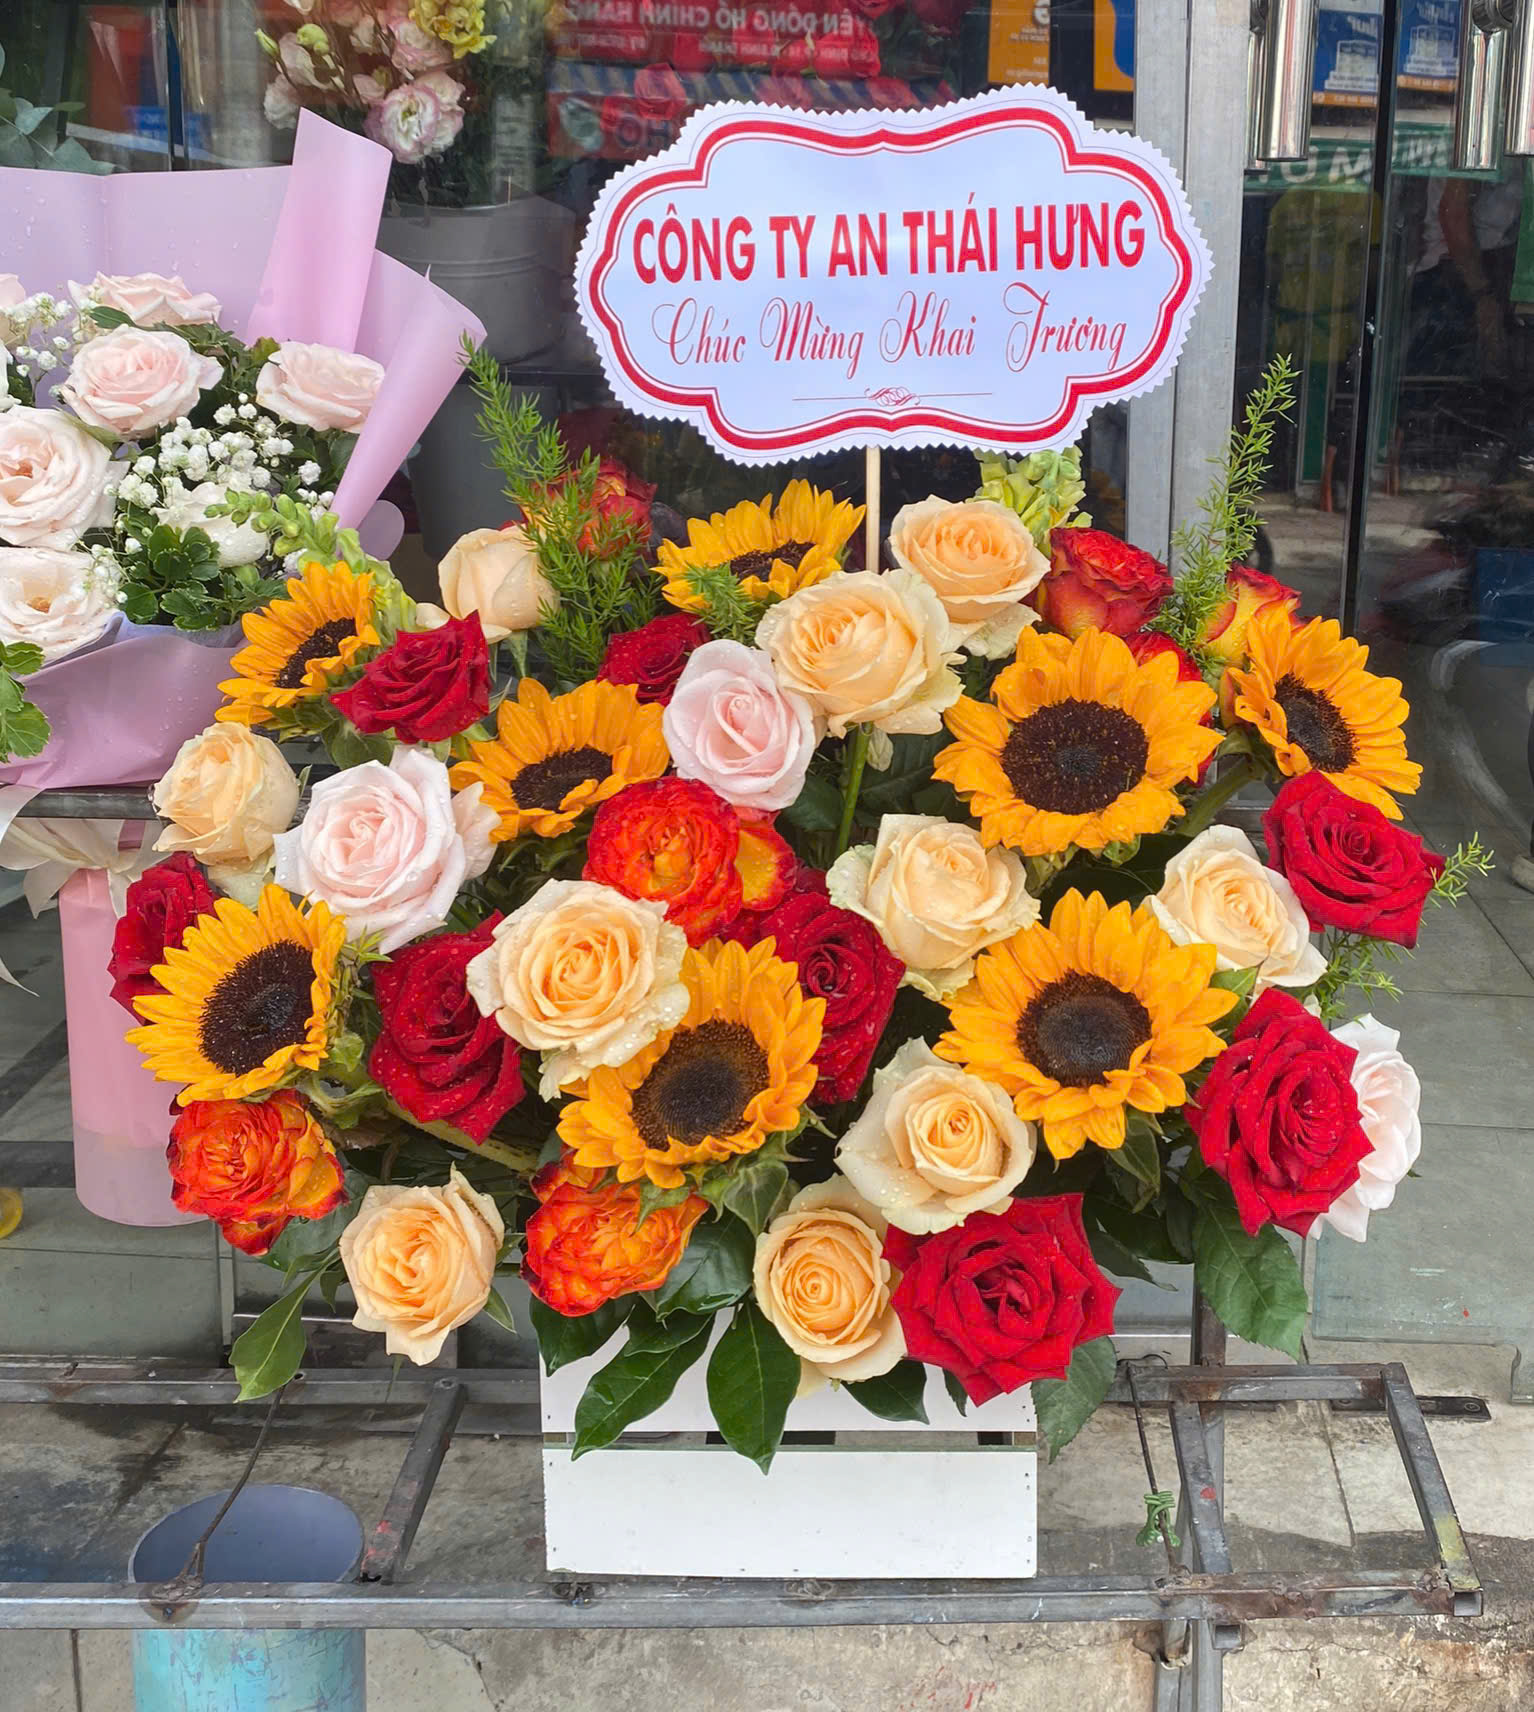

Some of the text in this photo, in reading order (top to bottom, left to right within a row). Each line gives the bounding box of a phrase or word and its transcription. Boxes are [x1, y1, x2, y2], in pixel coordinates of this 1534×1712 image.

[633, 192, 1146, 285] CÔNG TY AN THÁI HƯNG
[651, 281, 1128, 379] Chúc Mừng Khai Trương
